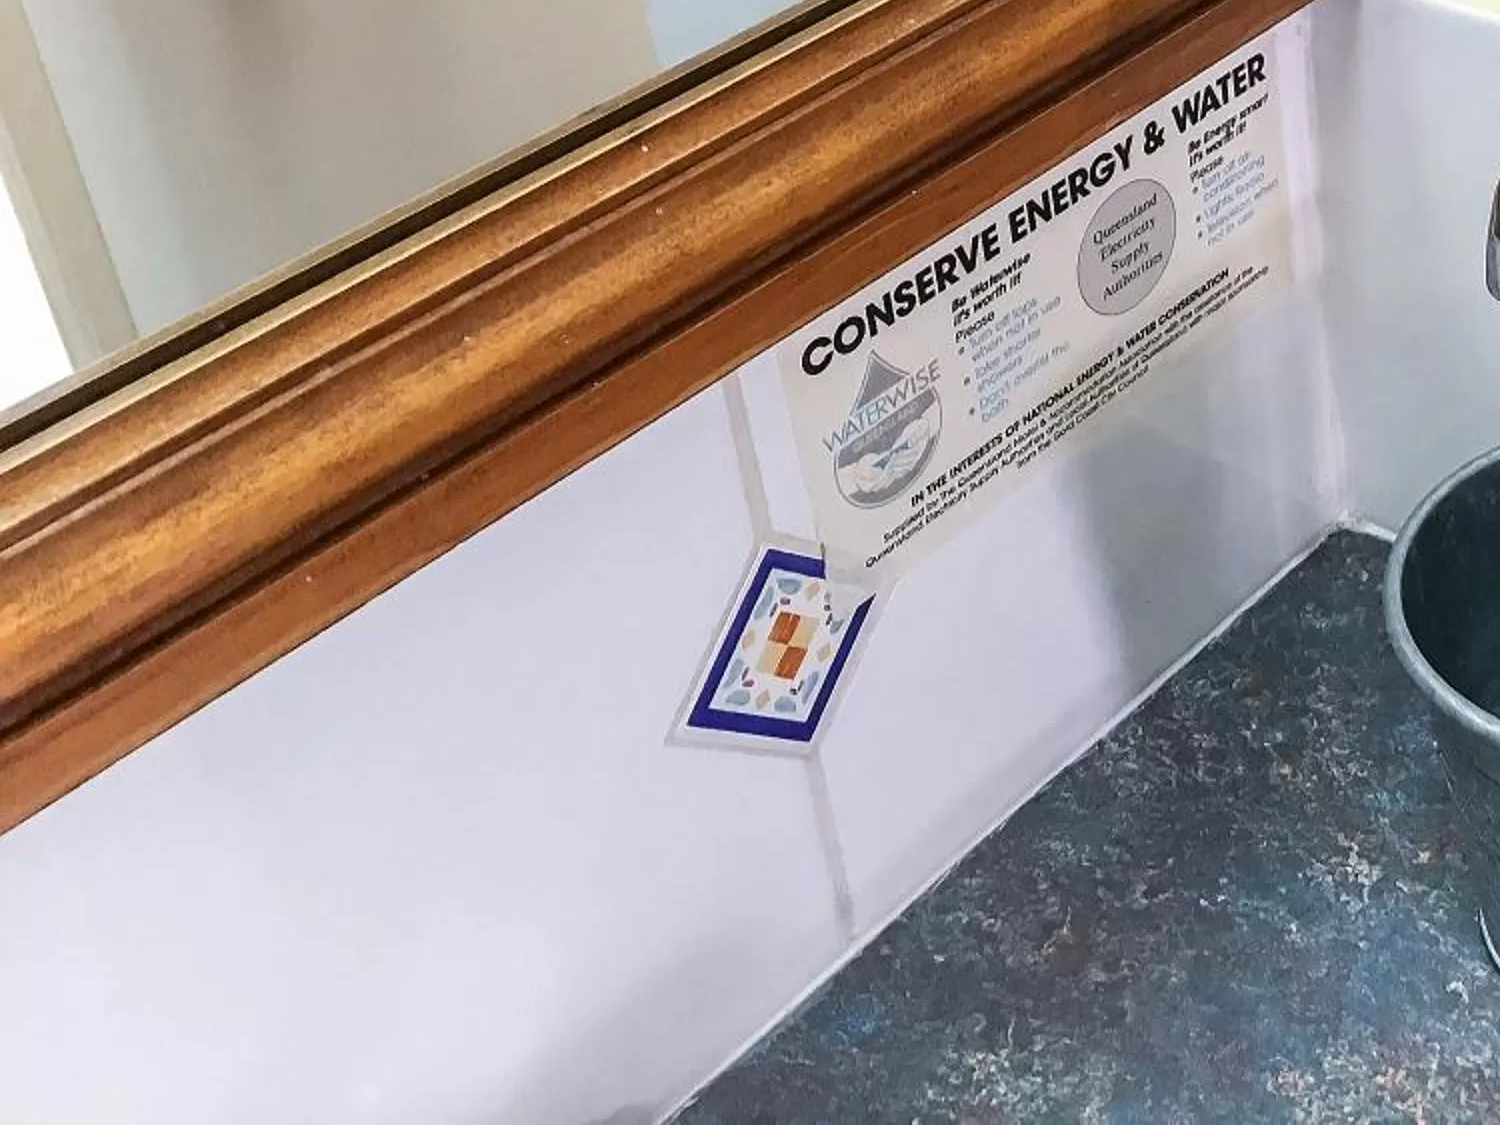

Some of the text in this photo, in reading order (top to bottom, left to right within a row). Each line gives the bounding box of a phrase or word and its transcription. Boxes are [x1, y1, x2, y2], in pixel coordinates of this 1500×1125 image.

[802, 53, 1266, 375] CONSERVE ENERGY & WATER
[1093, 193, 1157, 245] Queensland
[1100, 217, 1155, 262] Electricity
[952, 253, 1031, 313] Be Waterwise
[1104, 251, 1163, 301] Authorities
[1111, 242, 1149, 274] Supply
[955, 311, 995, 343] Please
[822, 358, 941, 452] WATERWISE
[911, 490, 924, 507] IN
[926, 473, 947, 495] THE
[949, 433, 1003, 479] INTERESTS
[1005, 420, 1020, 438] OF
[1022, 382, 1075, 426] NATIONAL
[1076, 351, 1114, 386] ENERGY
[1126, 321, 1156, 349] WATER
[1158, 268, 1229, 326] CONSERVATION
